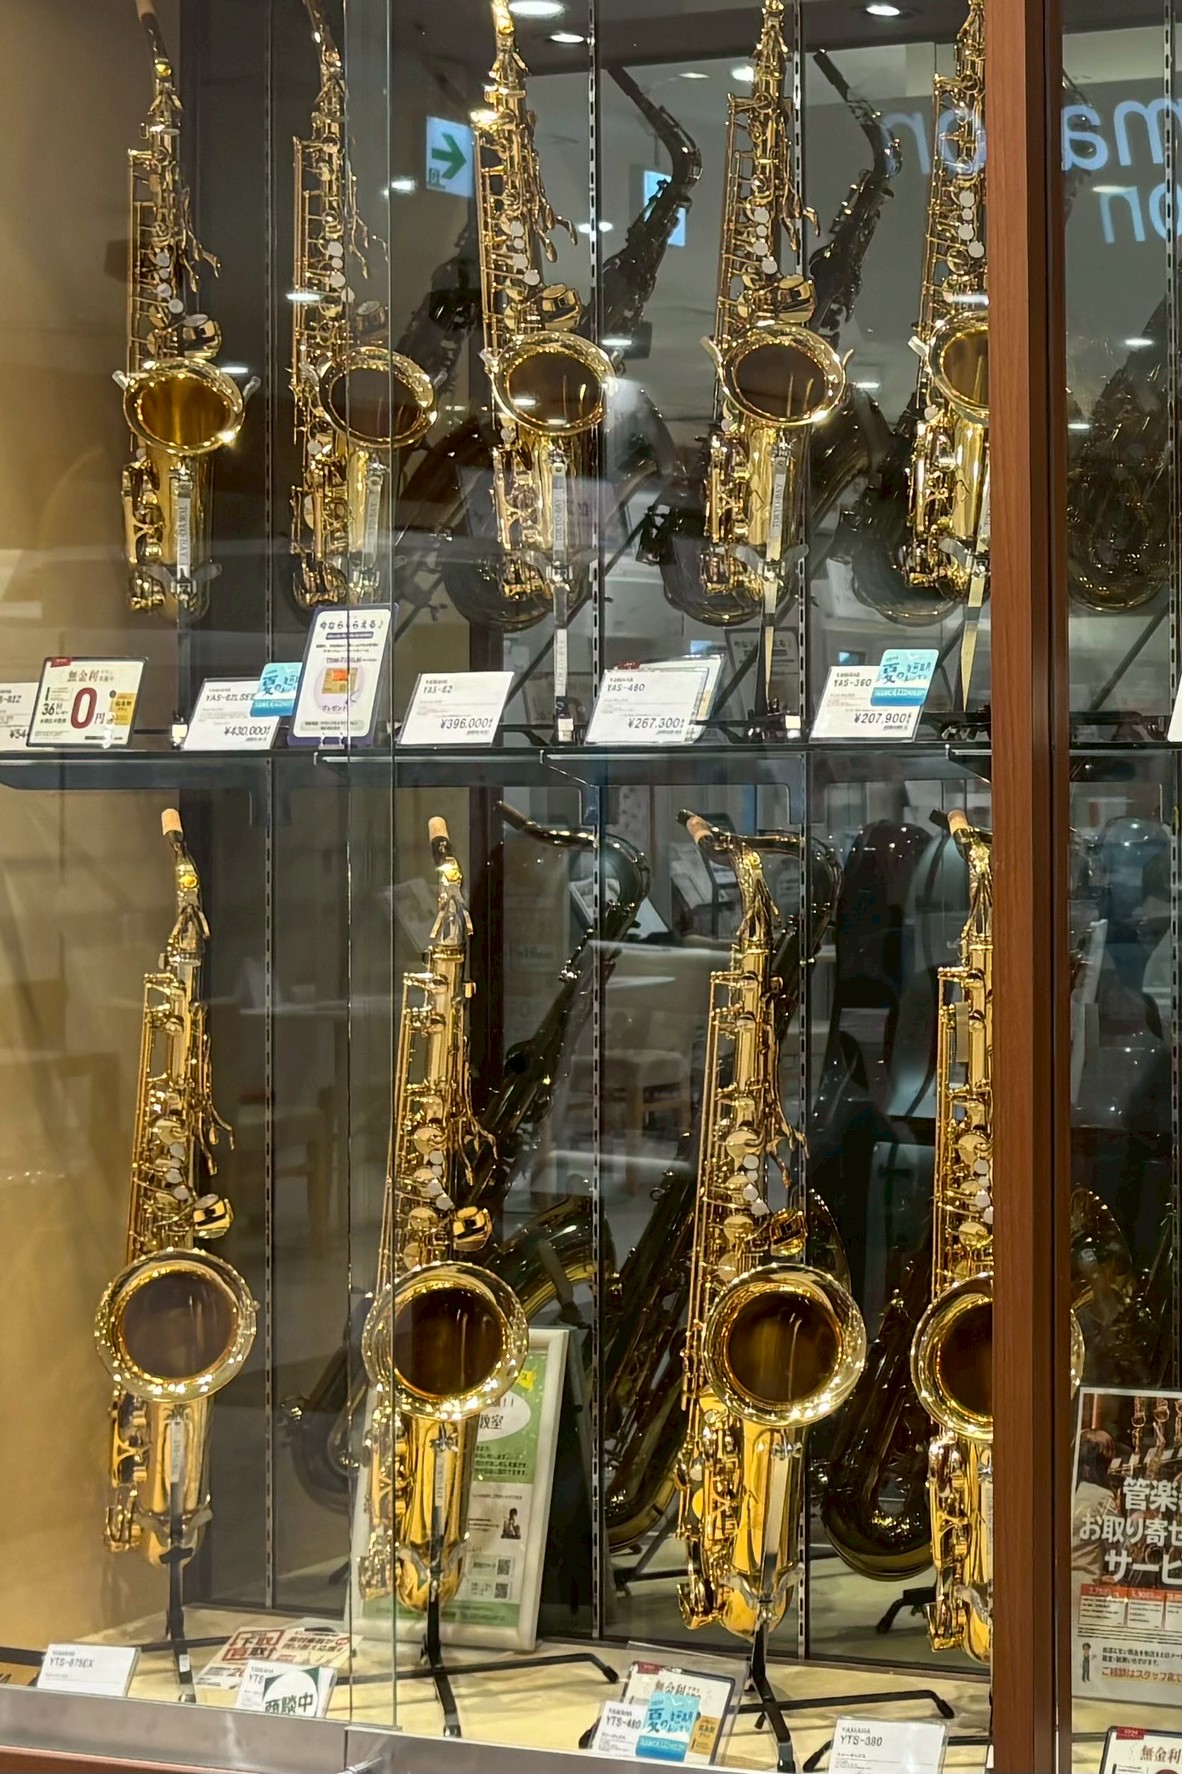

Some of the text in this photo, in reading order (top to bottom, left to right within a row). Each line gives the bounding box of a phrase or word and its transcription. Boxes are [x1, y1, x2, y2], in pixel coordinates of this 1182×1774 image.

[320, 620, 376, 630] 今なららえる
[423, 685, 453, 694] YAS-62
[607, 683, 645, 692] YAS-480
[440, 718, 490, 729] ¥396,000
[628, 718, 681, 729] ¥267,300
[854, 713, 907, 724] ¥207,900
[840, 1734, 883, 1747] YTS-380
[1140, 1745, 1182, 1766] 無金利
